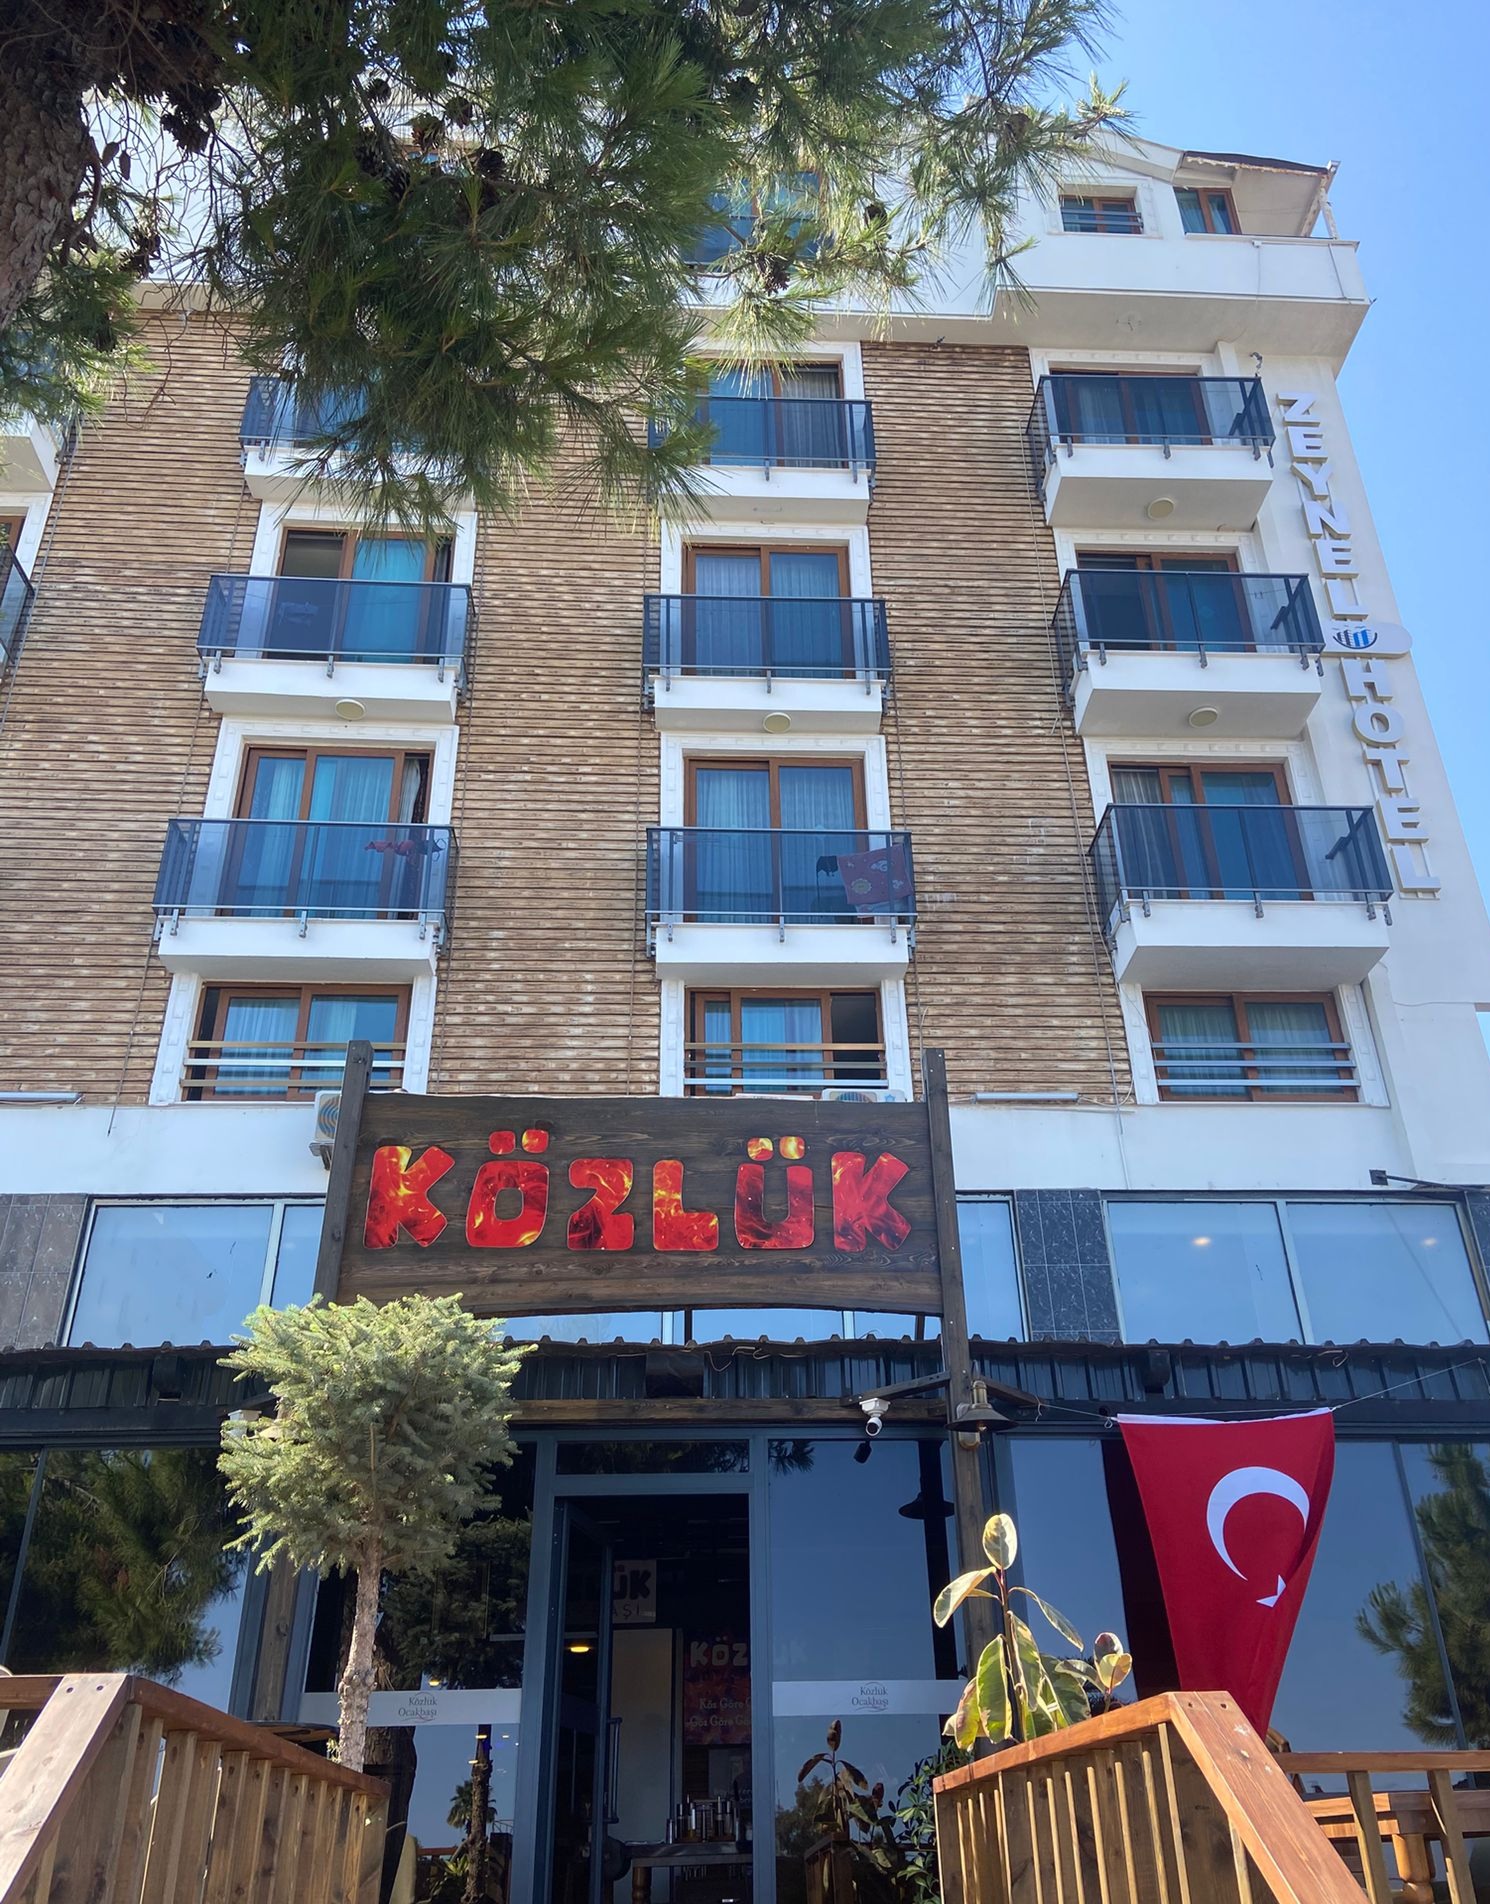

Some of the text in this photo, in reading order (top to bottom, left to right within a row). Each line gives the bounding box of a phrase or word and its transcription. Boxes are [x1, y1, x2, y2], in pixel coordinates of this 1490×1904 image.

[1276, 392, 1441, 893] ZEYNEL HOTEL
[364, 1128, 912, 1252] KÖZLÜK
